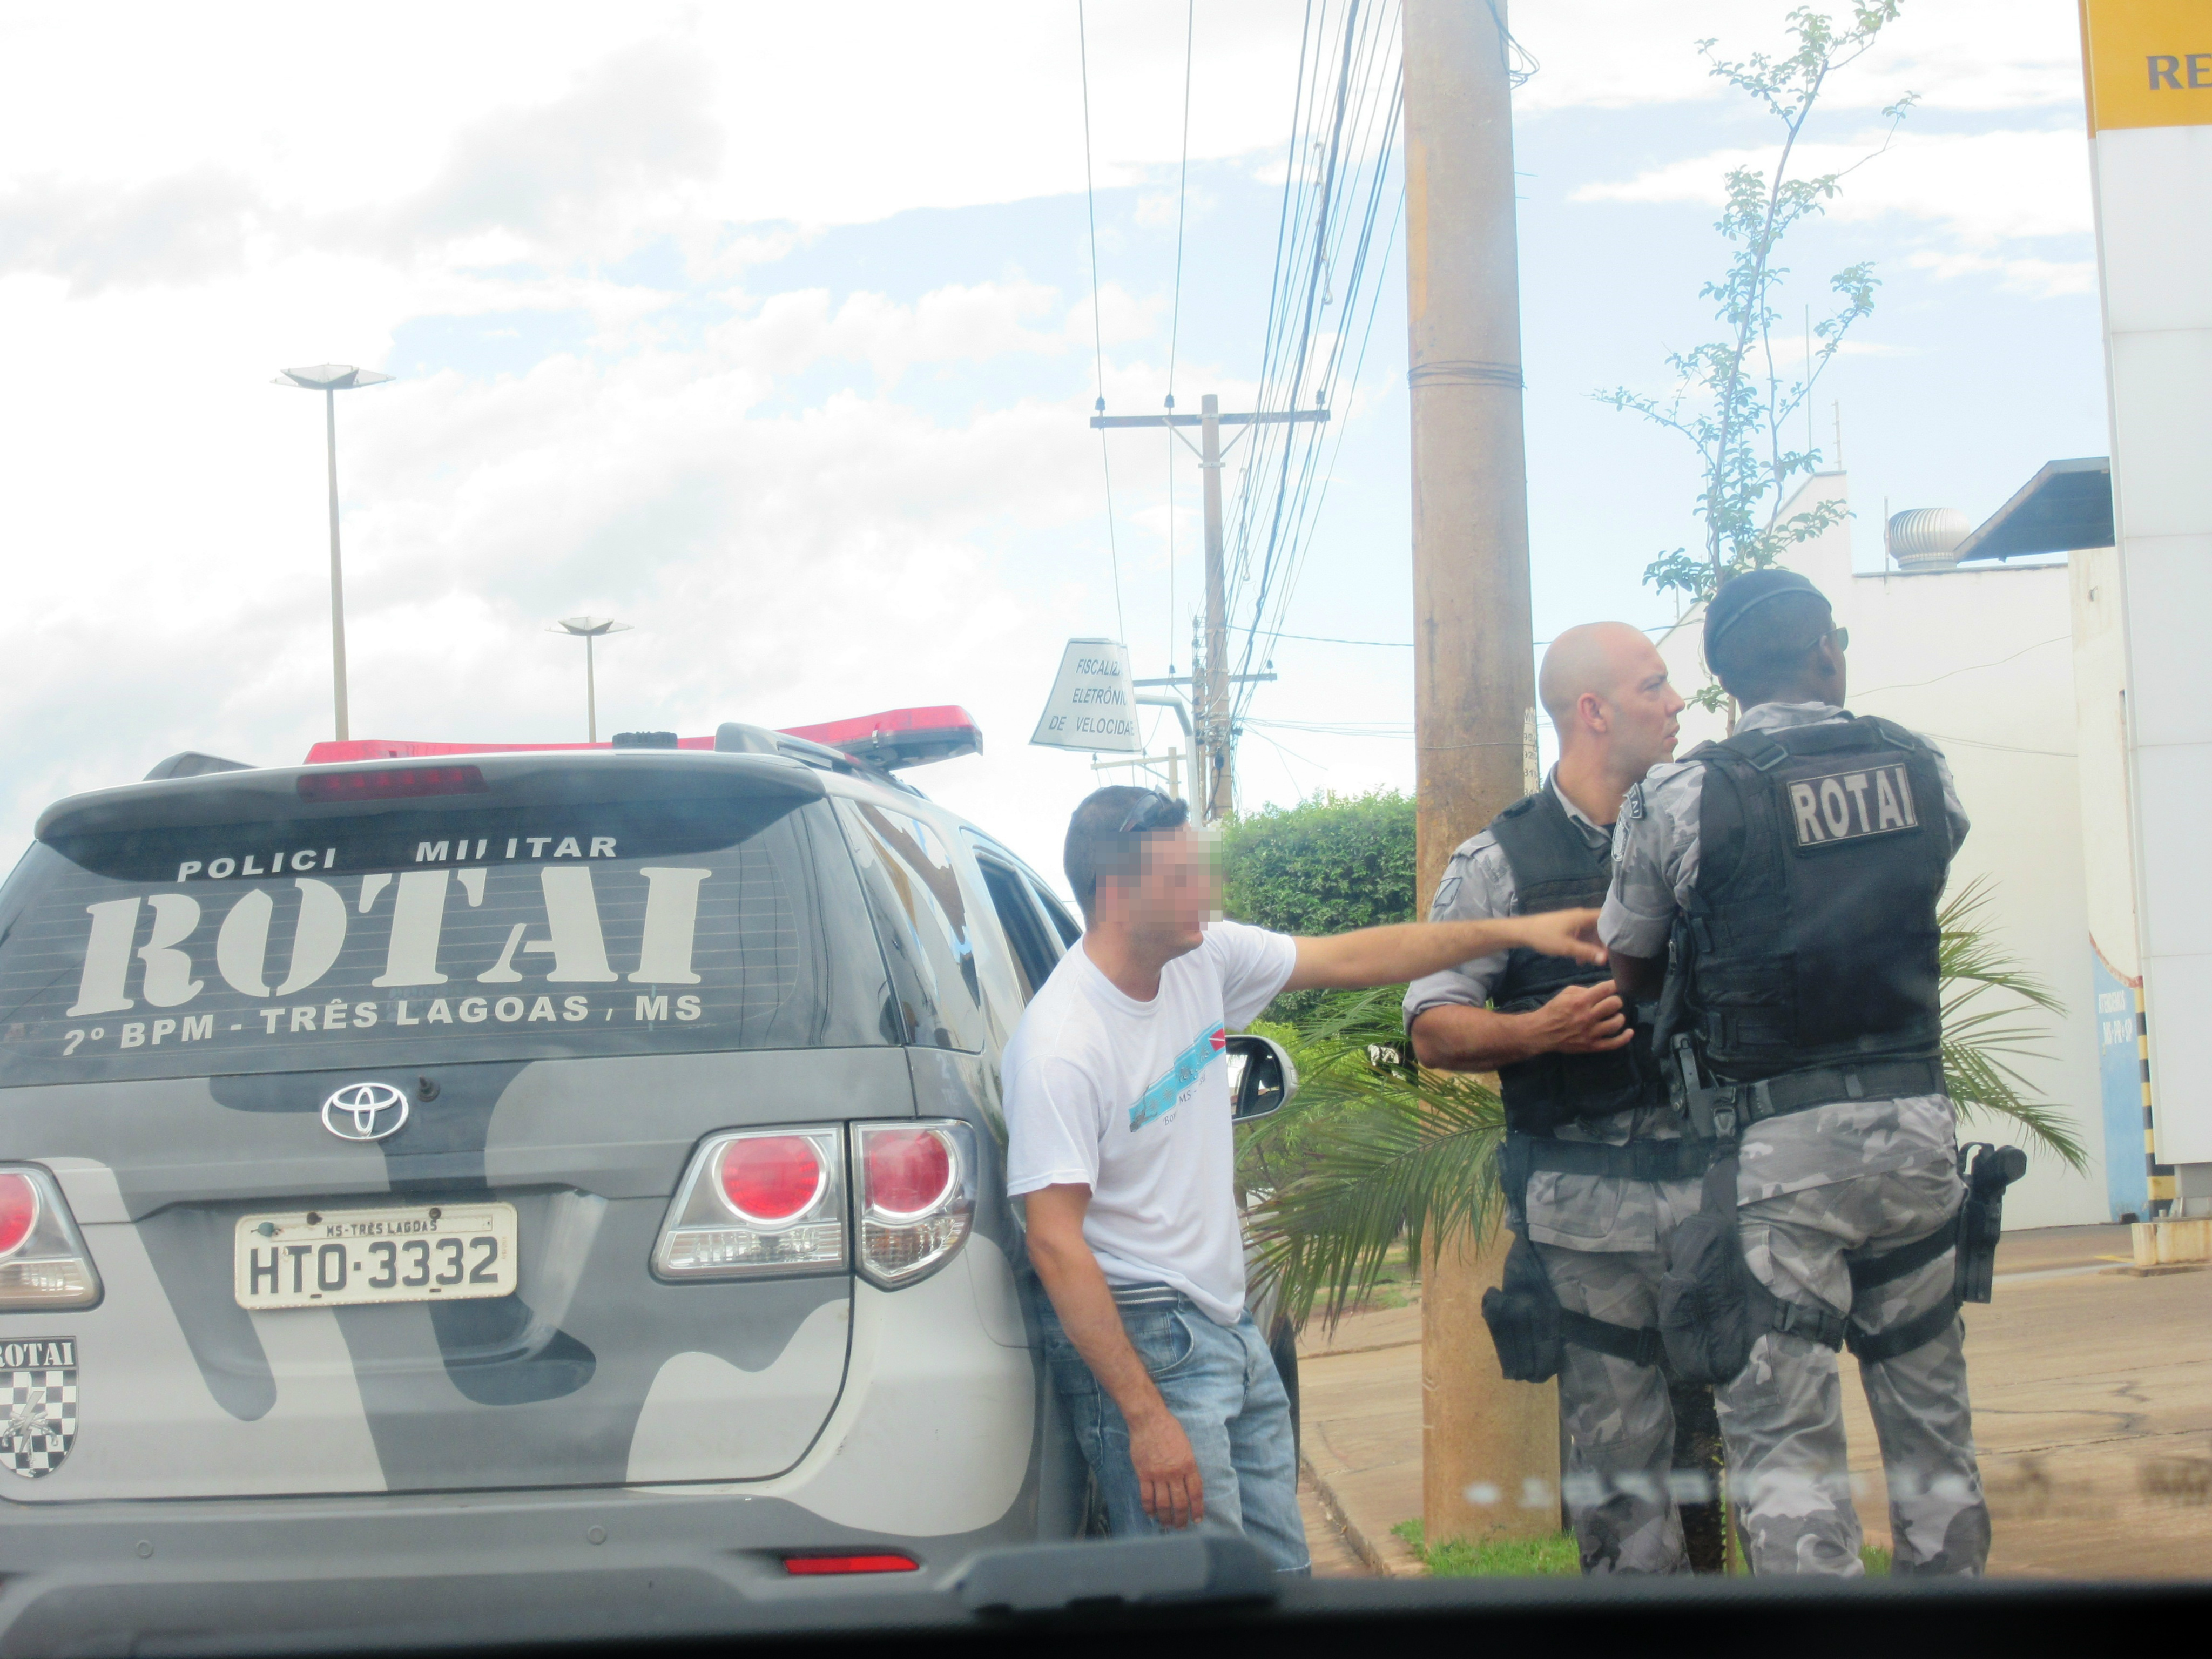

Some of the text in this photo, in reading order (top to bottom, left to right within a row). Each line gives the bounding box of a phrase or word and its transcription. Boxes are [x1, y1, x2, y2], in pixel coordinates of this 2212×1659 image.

[1076, 659, 1121, 676] FISCALIZ
[1048, 716, 1067, 731] DE
[1790, 768, 1913, 843] ROTAI
[66, 866, 712, 1017] ROTAI
[120, 1014, 213, 1049] BPM
[260, 999, 378, 1034] TRÊS
[397, 996, 588, 1026] LAGOAS
[635, 995, 701, 1021] MS
